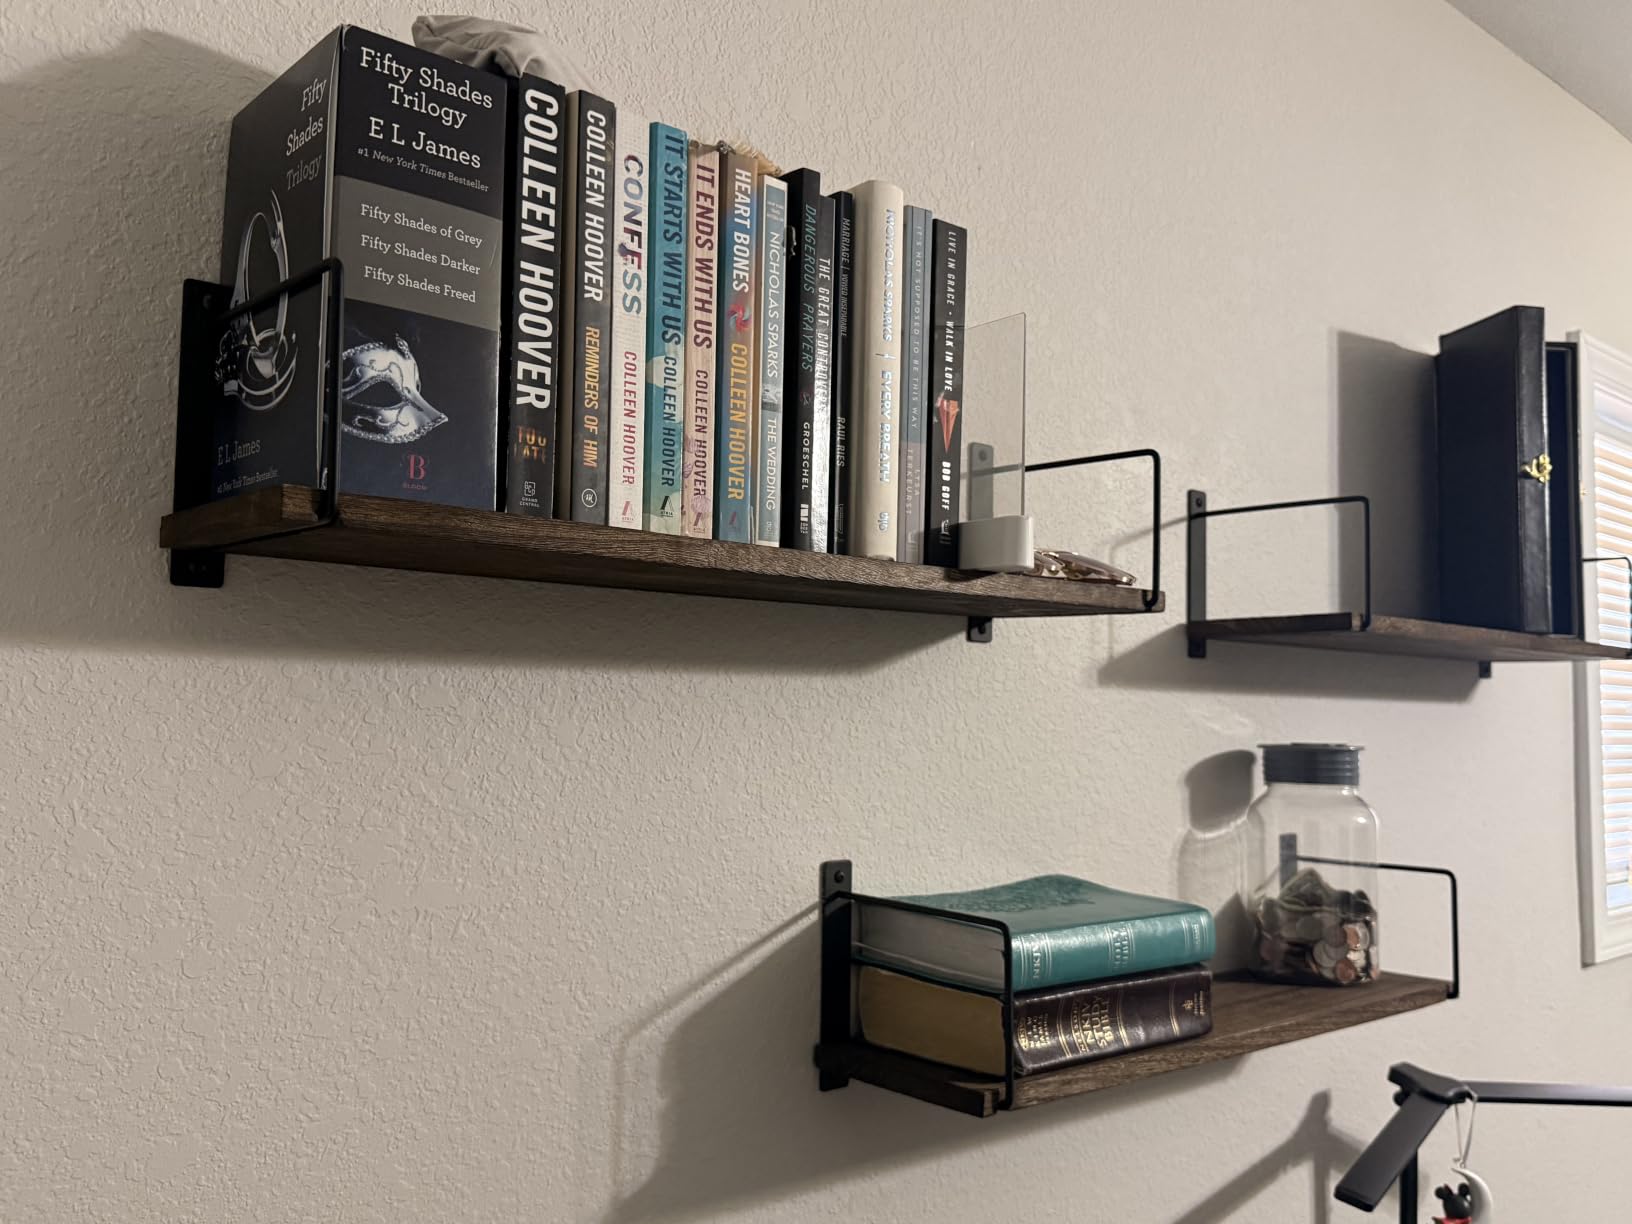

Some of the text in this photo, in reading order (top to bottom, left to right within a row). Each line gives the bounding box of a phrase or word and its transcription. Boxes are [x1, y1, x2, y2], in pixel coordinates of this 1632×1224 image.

[301, 78, 327, 112] Fifty
[360, 46, 493, 109] Fifty Shades
[388, 83, 468, 129] Trilogy
[286, 116, 324, 156] Shades
[369, 117, 481, 169] E L James
[286, 155, 322, 191] Trilogy
[373, 150, 394, 164] New
[396, 156, 418, 171] York
[419, 163, 447, 180] Times
[448, 171, 489, 192] Bestseller
[360, 203, 483, 249] Fifty Shades of Grey
[584, 109, 607, 302] COLLEEN HOOVER
[622, 154, 644, 315] CONFESS
[732, 168, 752, 293] HEART BONES
[360, 234, 481, 275] Fifty Shades Darker
[516, 88, 559, 409] COLLEEN HOOVER
[662, 134, 684, 346] IT STARTS WITH US
[693, 164, 715, 350] IT ENDS WITH US
[818, 258, 831, 281] THE
[364, 265, 476, 303] Fifty Shades Freed
[767, 231, 783, 319] NICHOLAS
[801, 204, 817, 373] DANGEROUS PRAYERS
[840, 217, 850, 337] MARRIAGE VOWED INSEPARABLE
[883, 209, 895, 342] NICHOLAS SPARKS
[817, 287, 830, 327] GREAT
[911, 226, 922, 429] IT'S NOT SUPPOSED TO BE THIS WAY
[944, 232, 957, 392] LIVE IN GRACE WALK IN LOVE
[766, 322, 779, 378] SPARKS
[583, 325, 600, 469] REMINDERS OF HIM
[622, 350, 637, 486] COLLEEN HOOVER
[661, 354, 677, 487] COLLEEN HOOVER
[727, 343, 748, 501] COLLEEN HOOVER
[880, 370, 892, 484] EVERY BREATH
[217, 439, 261, 466] E L James
[693, 369, 708, 497] COLLEEN HOOVER
[766, 418, 777, 442] THE
[801, 422, 811, 490] GROESCHEL
[836, 416, 846, 467] RAUL RIES
[764, 445, 777, 510] WEDDING
[905, 449, 913, 515] TERKEURST
[941, 485, 950, 511] GOFF
[942, 461, 951, 482] BOB
[519, 500, 540, 508] CENTRAL
[1081, 1002, 1096, 1044] NKJV
[1091, 996, 1107, 1048] STUDY
[1100, 1001, 1114, 1041] BIBLE
